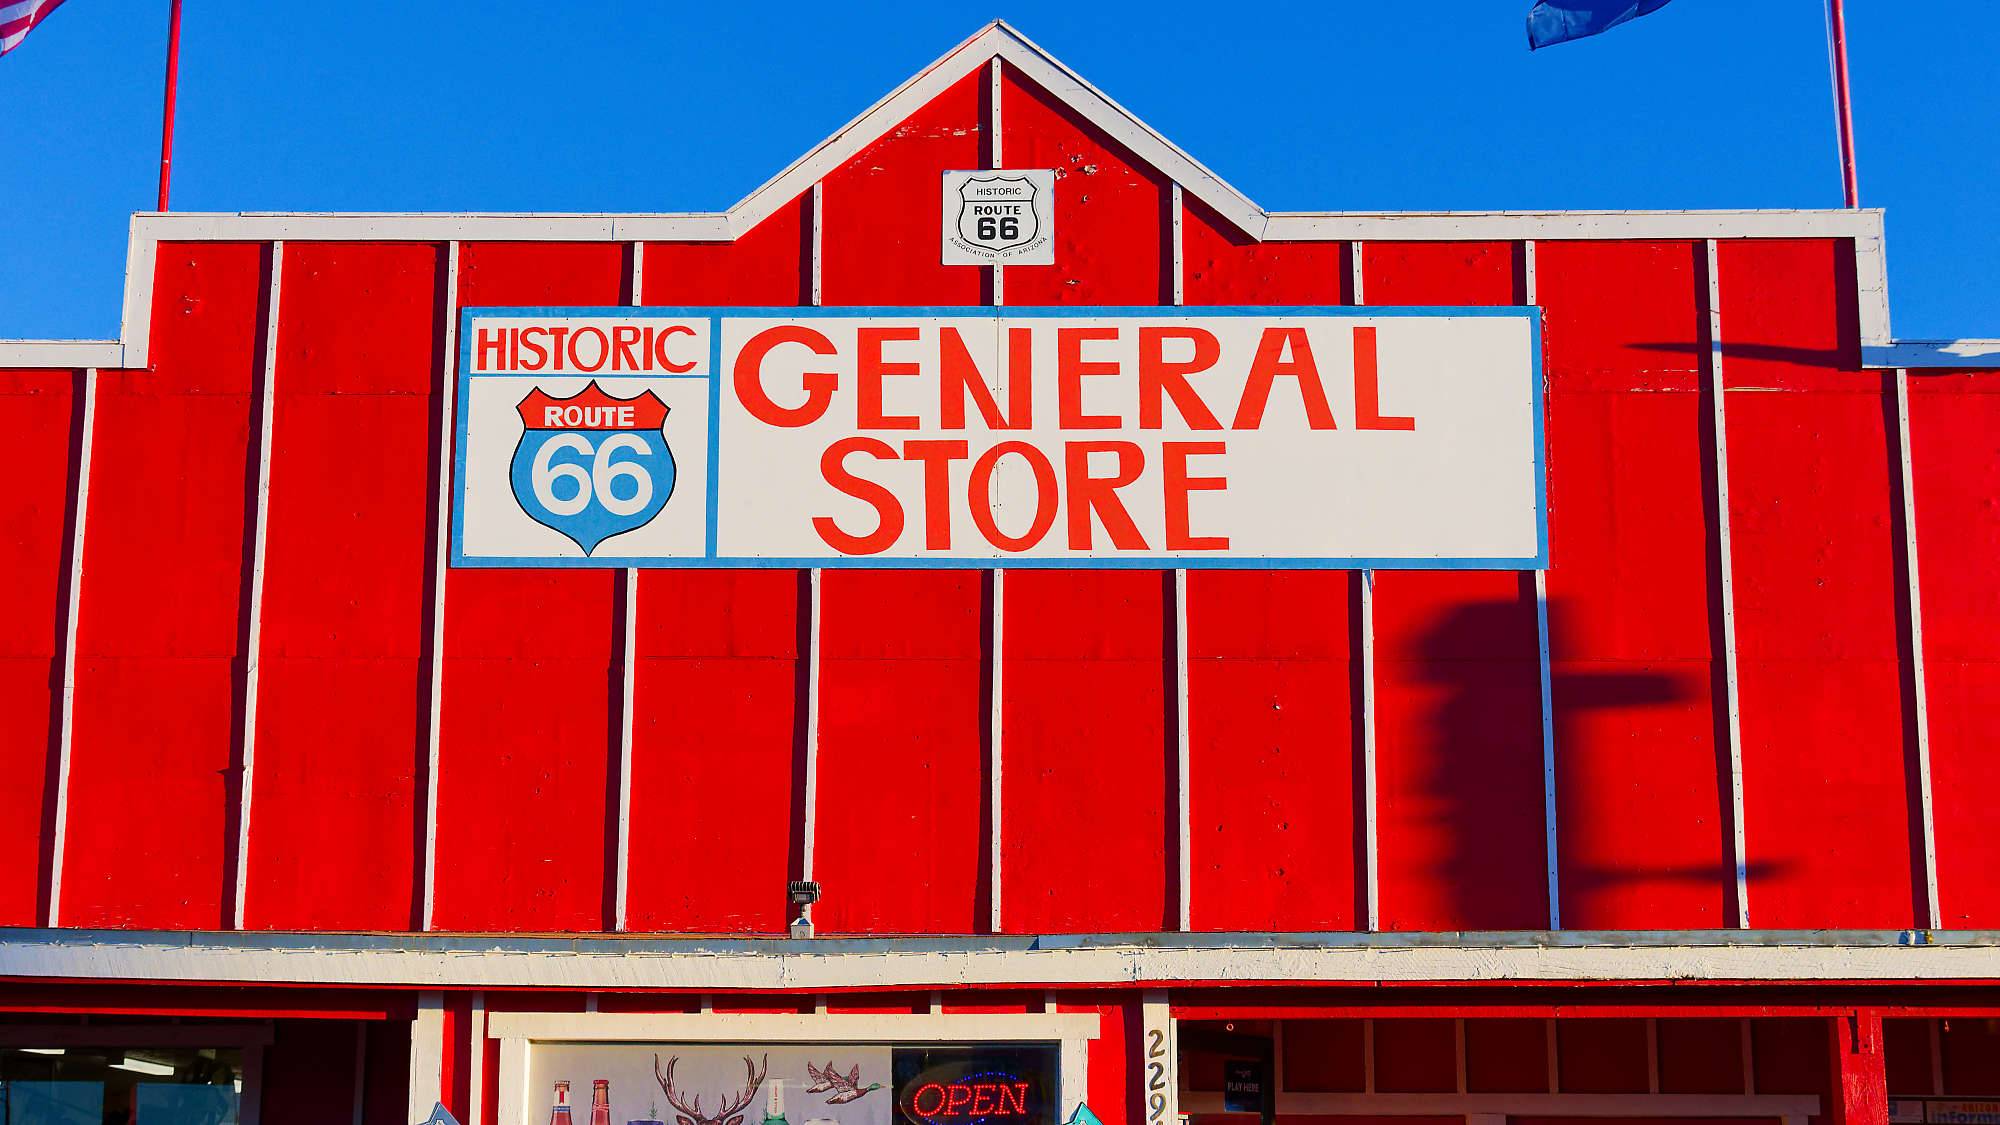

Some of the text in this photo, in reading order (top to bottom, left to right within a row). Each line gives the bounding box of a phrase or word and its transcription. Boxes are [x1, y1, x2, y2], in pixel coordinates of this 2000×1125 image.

[976, 187, 1022, 196] HISTORIC
[974, 205, 1022, 216] ROUTE
[977, 217, 1019, 240] 66
[949, 236, 995, 259] ASSOCIATION
[1018, 236, 1048, 255] ARIZONA
[477, 325, 698, 373] HISTORIC
[733, 325, 1415, 432] GENERAL
[544, 405, 635, 427] ROUTE
[531, 432, 654, 516] 66
[812, 436, 1230, 555] STORE
[1147, 1029, 1167, 1125] 229
[1227, 1081, 1260, 1093] PLAY HERE
[913, 1083, 1029, 1117] OPEN
